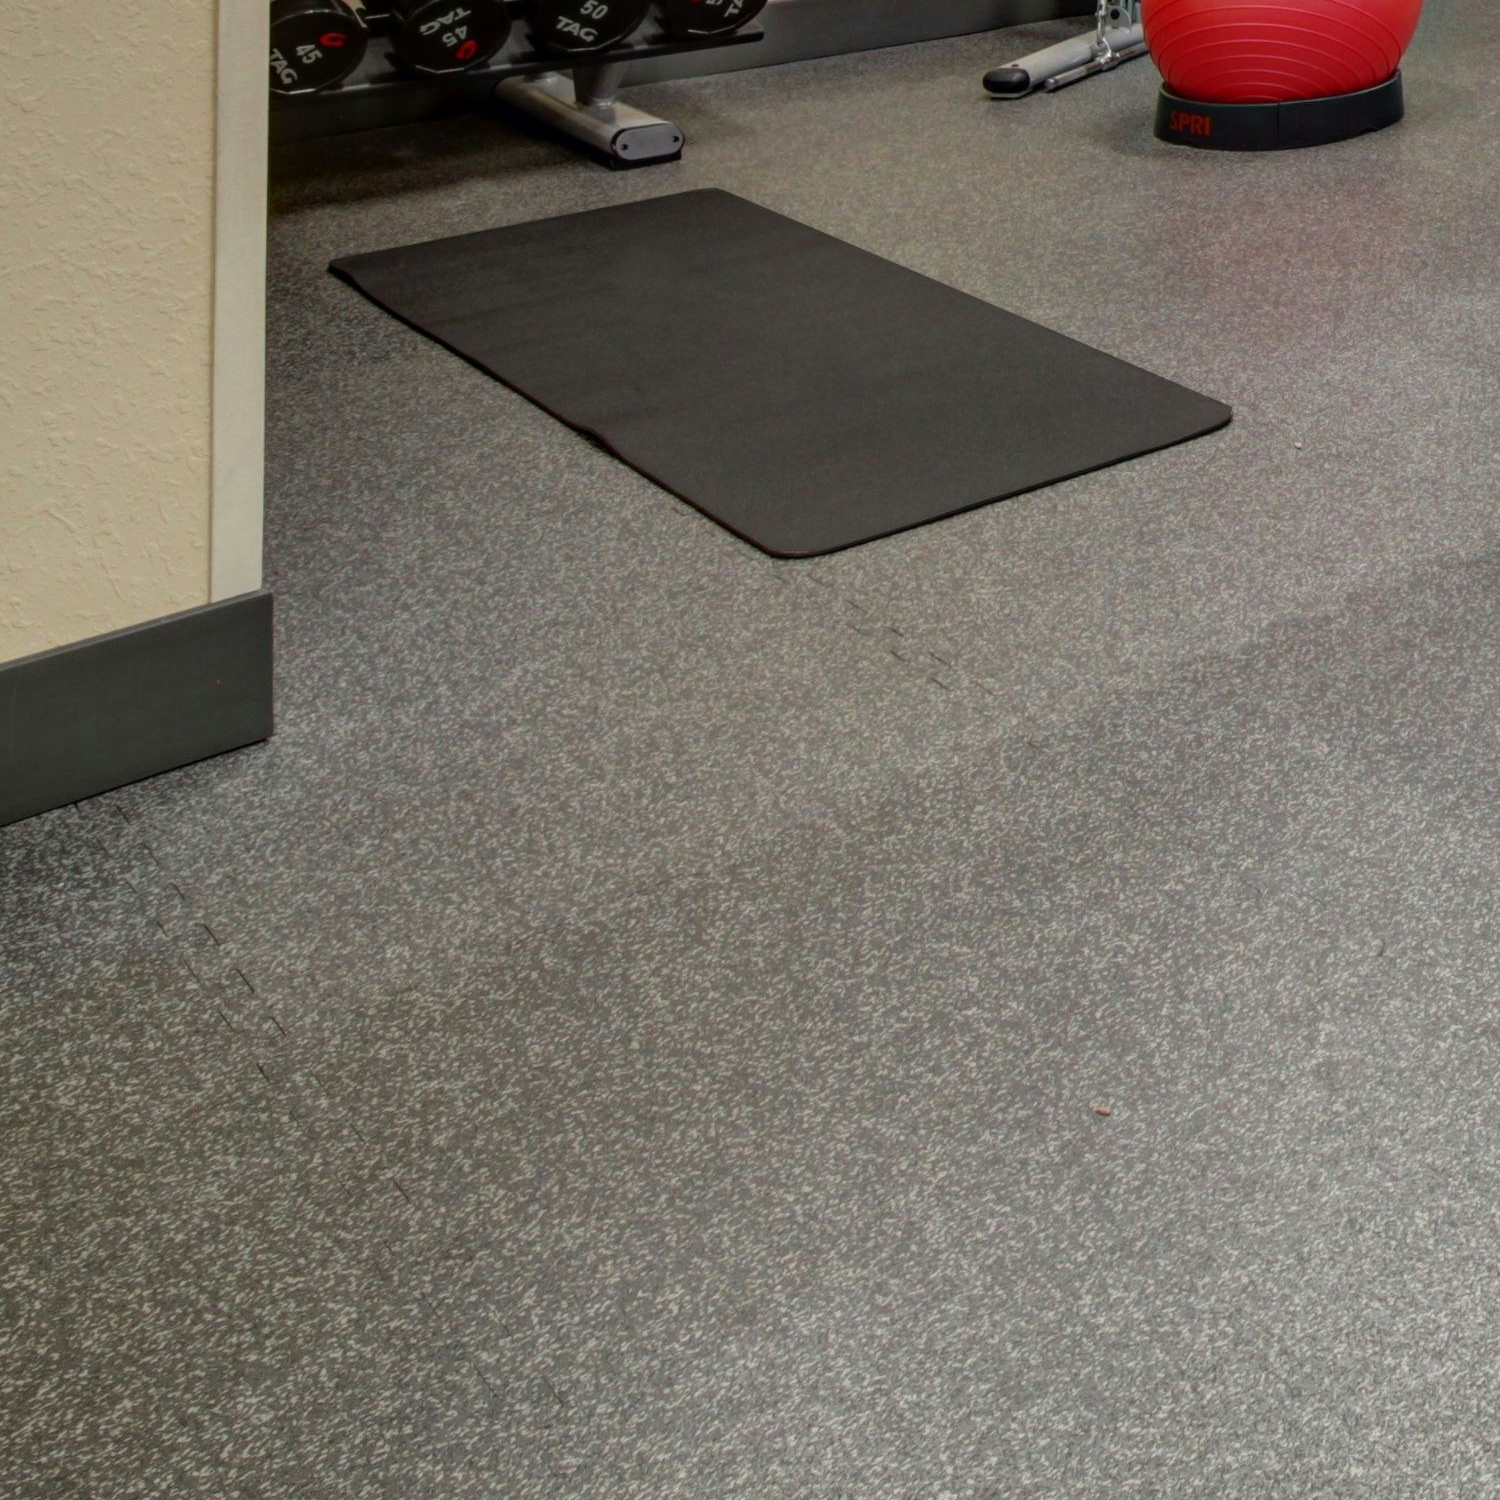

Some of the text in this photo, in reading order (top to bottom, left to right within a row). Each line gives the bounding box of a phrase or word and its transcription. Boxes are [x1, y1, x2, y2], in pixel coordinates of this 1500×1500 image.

[419, 6, 472, 36] TAG
[580, 0, 608, 20] 50
[442, 25, 469, 48] 45
[555, 16, 599, 43] TAG
[269, 48, 298, 85] TAG
[295, 44, 323, 64] 45
[1169, 110, 1212, 136] SPRI
